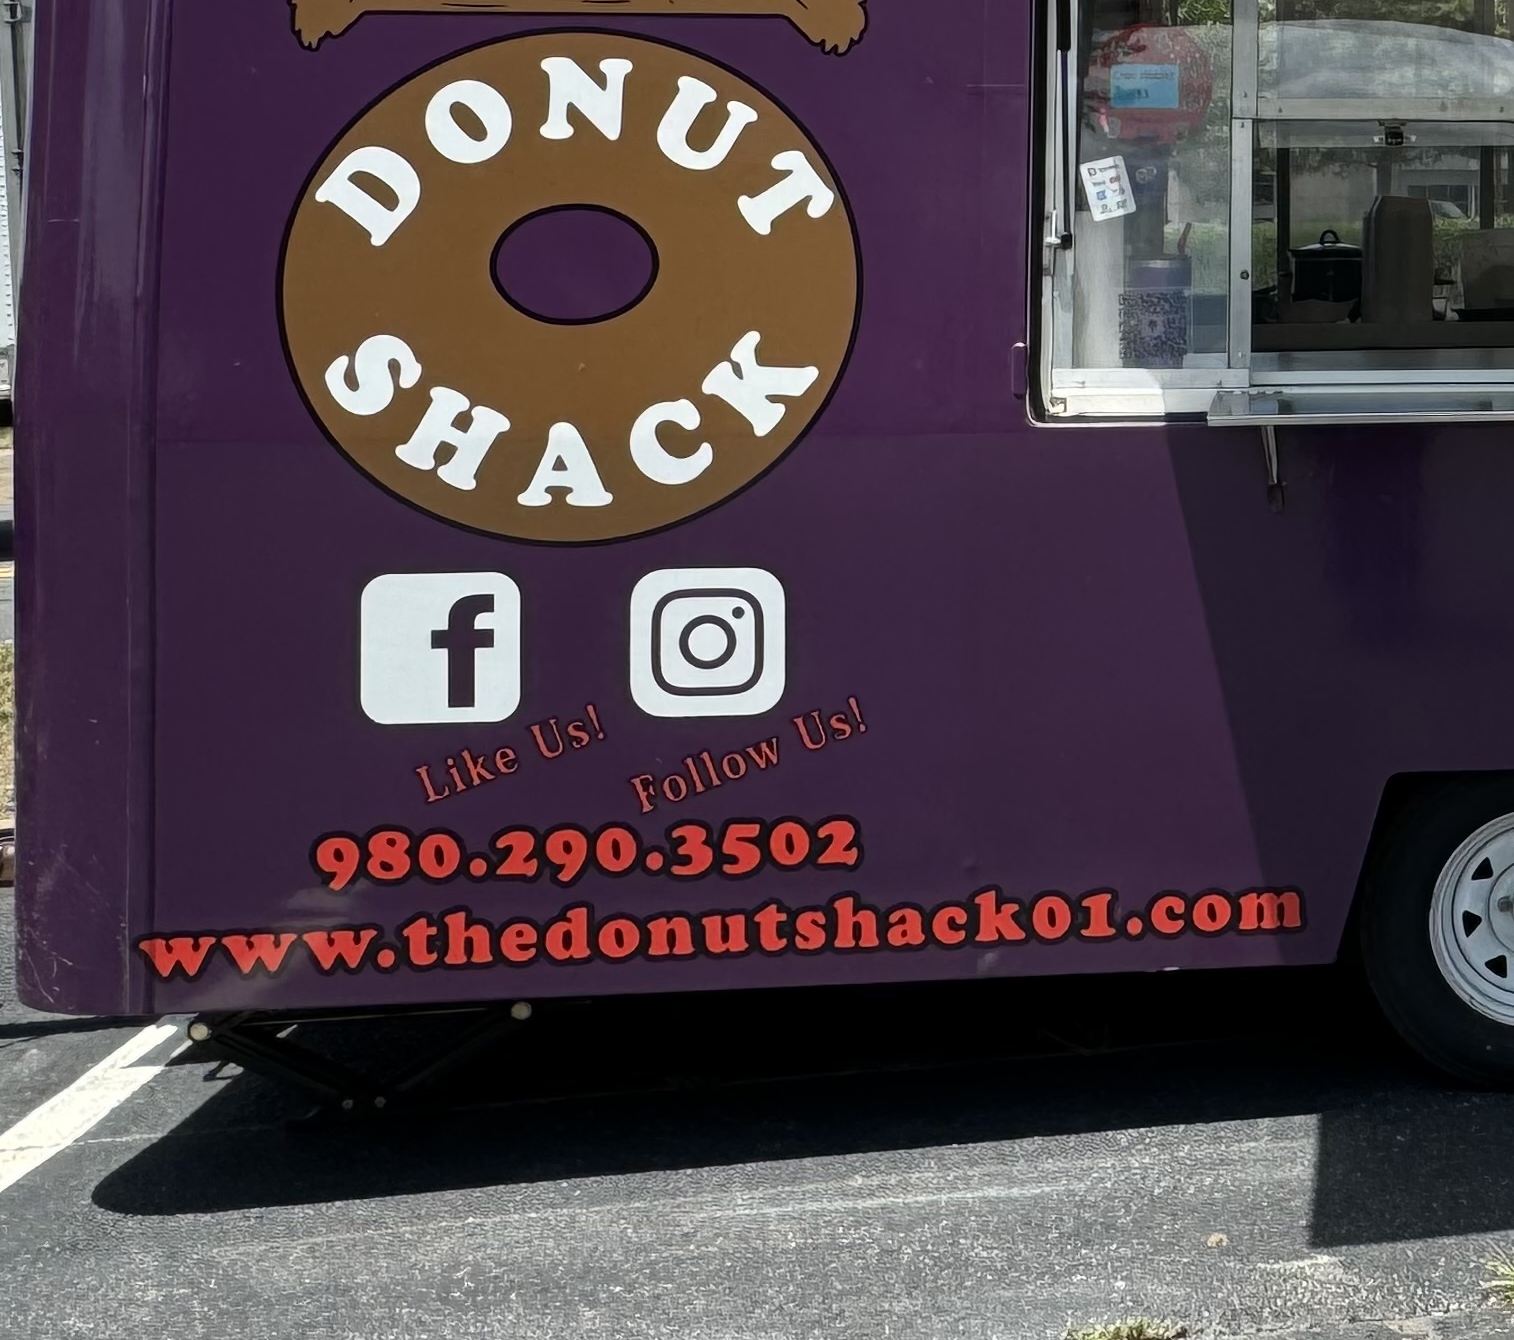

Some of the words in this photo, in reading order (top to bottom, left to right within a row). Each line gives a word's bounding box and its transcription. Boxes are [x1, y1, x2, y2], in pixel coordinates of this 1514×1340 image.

[316, 56, 835, 247] DONUT
[325, 331, 820, 508] SHACK
[414, 746, 520, 804] Like
[530, 704, 606, 759] Us!
[630, 732, 782, 814] Follow
[793, 696, 869, 752] Us!
[314, 819, 860, 891] 980.290.3502
[139, 891, 1302, 978] www.thedonutshack01.com
